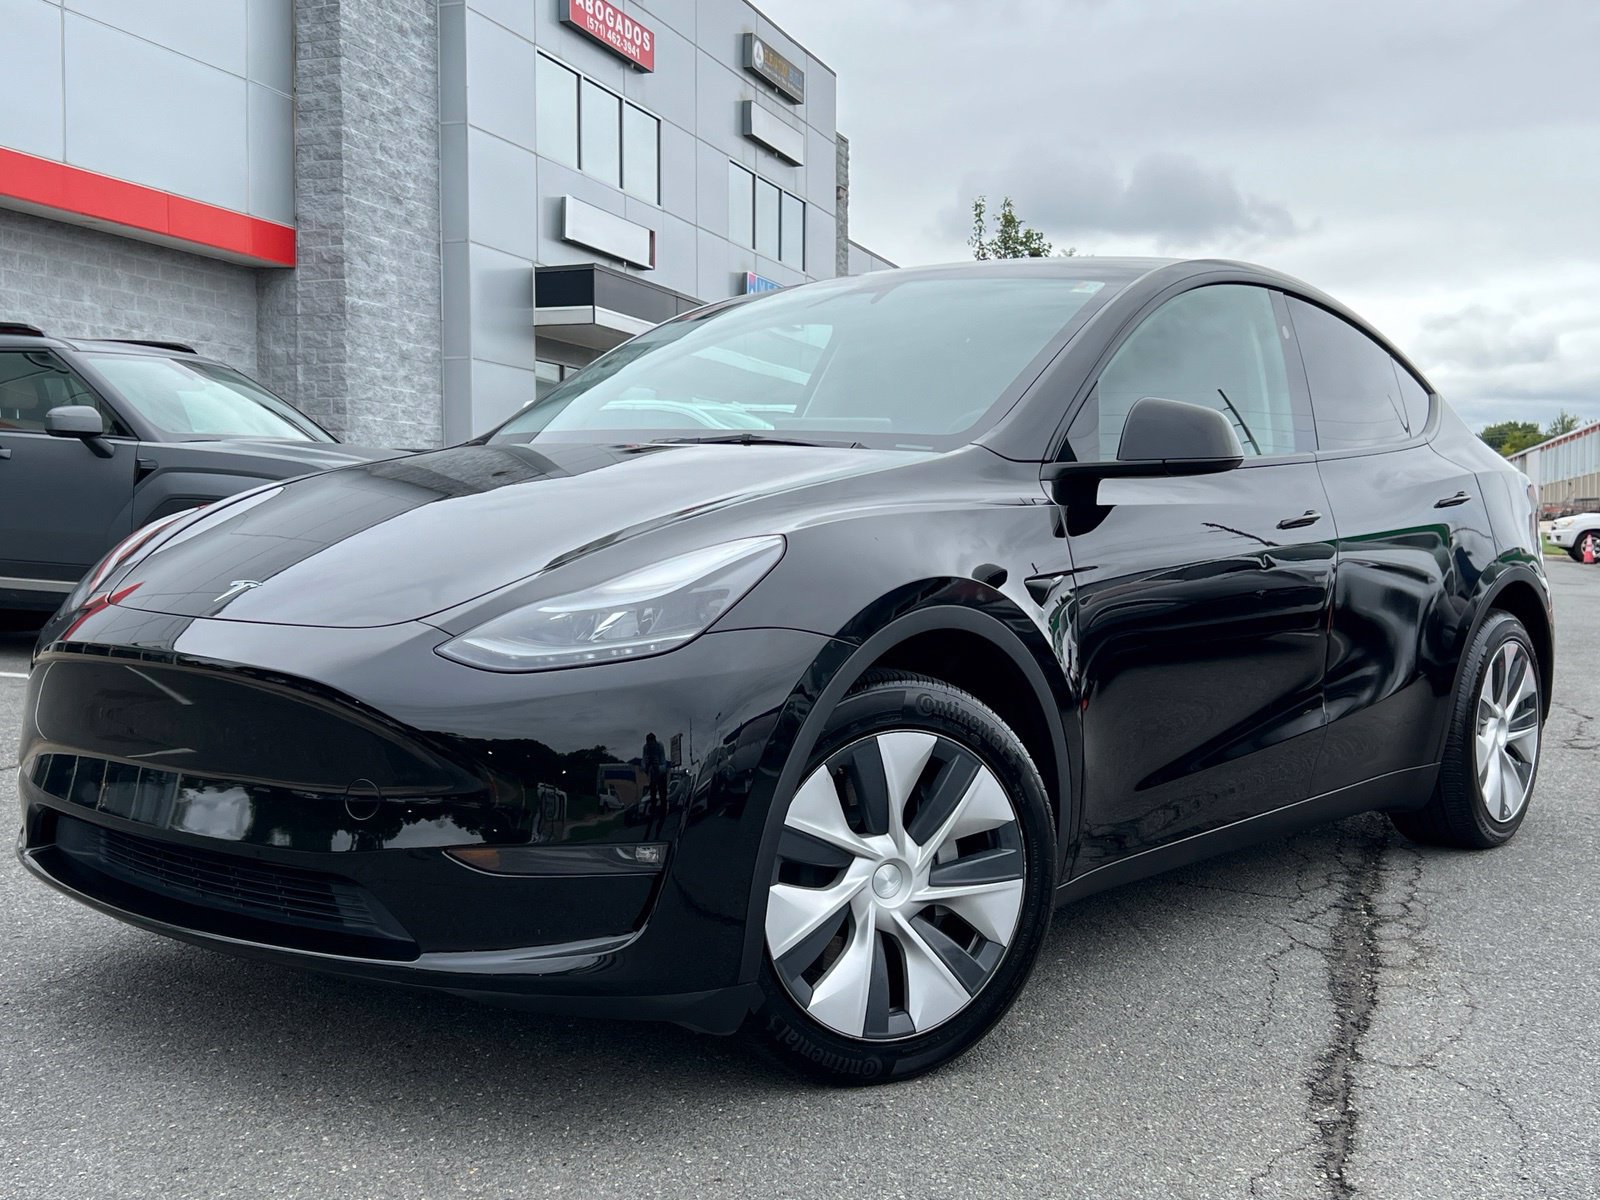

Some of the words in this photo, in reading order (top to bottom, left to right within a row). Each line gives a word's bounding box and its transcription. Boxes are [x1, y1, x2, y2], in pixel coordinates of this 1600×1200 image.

[587, 15, 606, 38] (571)
[607, 29, 640, 60] 462-3941
[916, 693, 1008, 753] Continental
